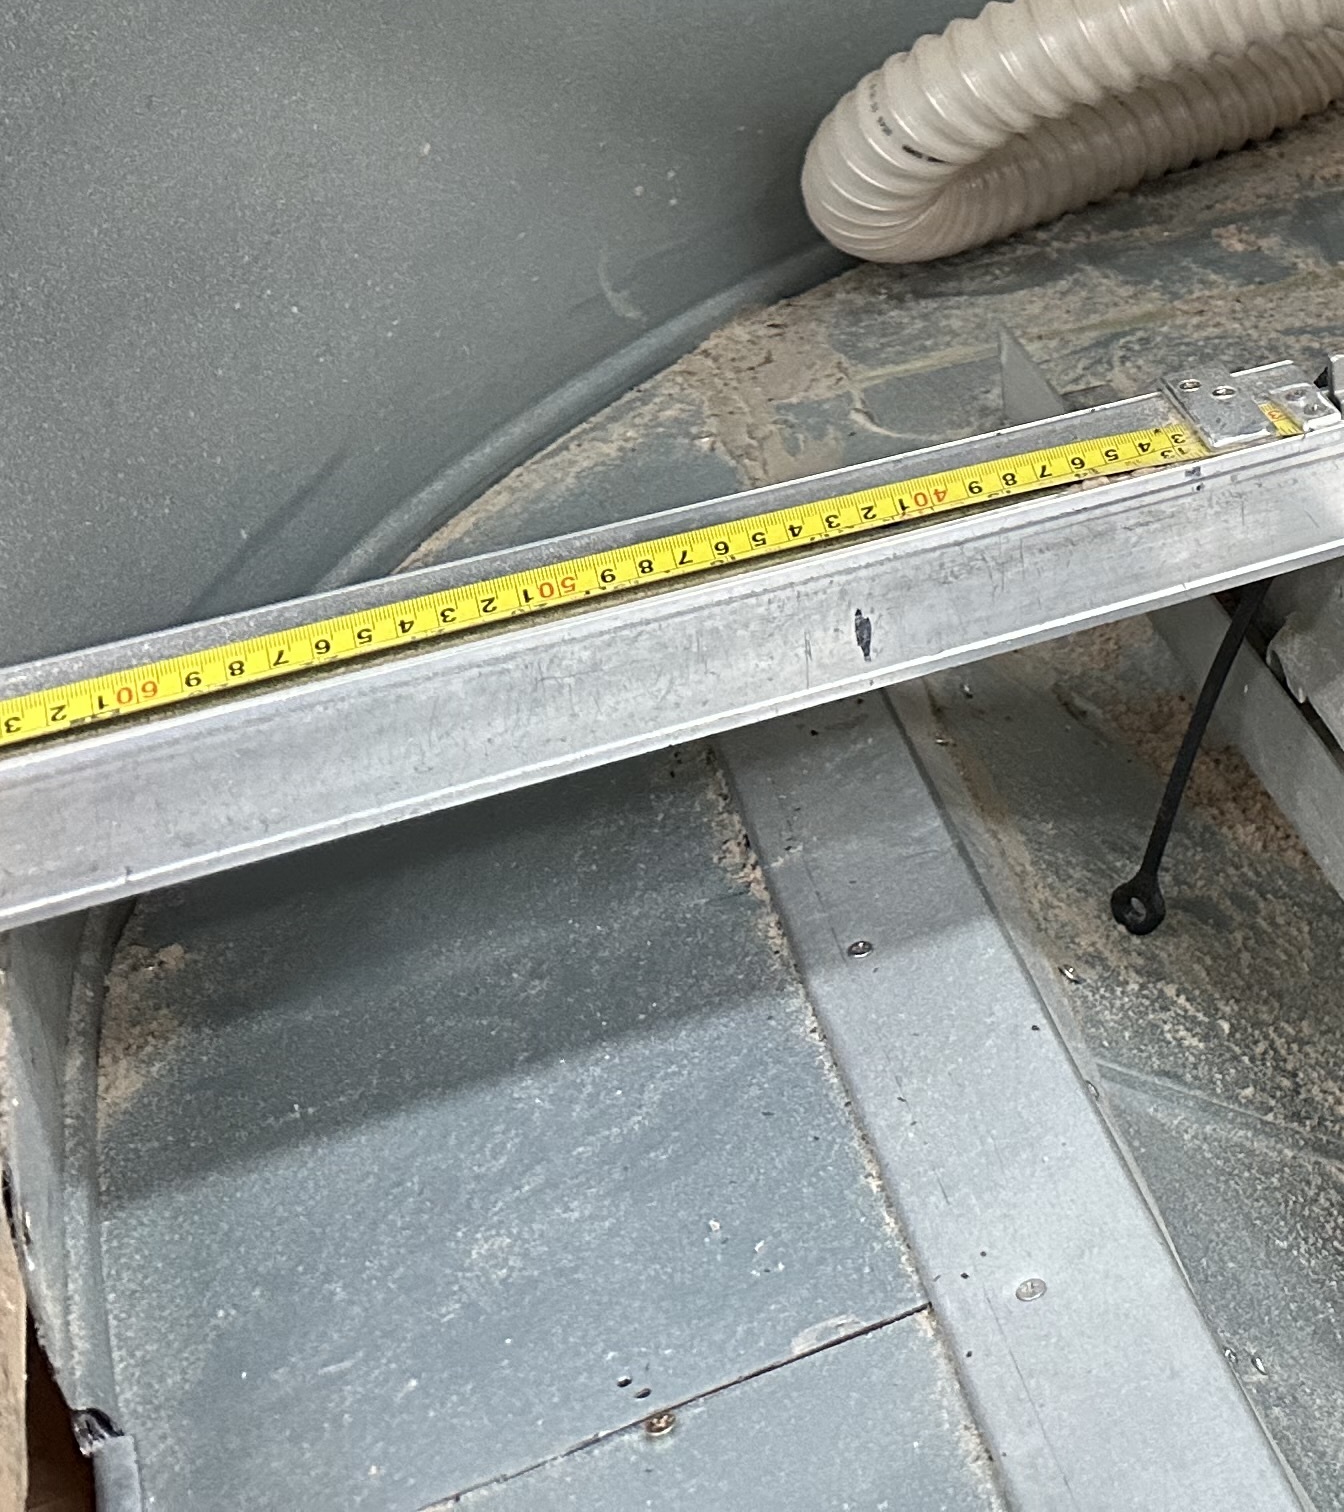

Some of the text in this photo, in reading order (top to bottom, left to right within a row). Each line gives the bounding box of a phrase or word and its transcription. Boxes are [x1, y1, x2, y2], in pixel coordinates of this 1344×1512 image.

[1170, 433, 1186, 444] 3
[1137, 442, 1151, 453] 4
[1104, 449, 1119, 462] 5
[1070, 457, 1085, 470] 6
[1038, 465, 1053, 478] 7
[1002, 472, 1018, 487] 8
[967, 480, 983, 495] 9
[898, 498, 910, 512] 1
[914, 488, 947, 507] 40
[861, 505, 877, 520] 2
[825, 514, 841, 529] 3
[788, 524, 803, 538] 4
[751, 532, 767, 547] 5
[714, 541, 730, 556] 6
[678, 550, 694, 566] 7
[638, 559, 654, 574] 8
[600, 568, 616, 583] 9
[539, 576, 576, 598] 50
[522, 588, 534, 603] 1
[481, 597, 497, 613] 2
[440, 607, 456, 623] 3
[398, 620, 414, 634] 4
[357, 628, 373, 644] 5
[314, 639, 331, 653] 6
[272, 649, 290, 667] 7
[228, 660, 245, 677] 8
[184, 671, 202, 687] 9
[116, 680, 158, 704] 60
[97, 695, 110, 710] 1
[49, 704, 67, 722] 2
[4, 716, 22, 733] 3
